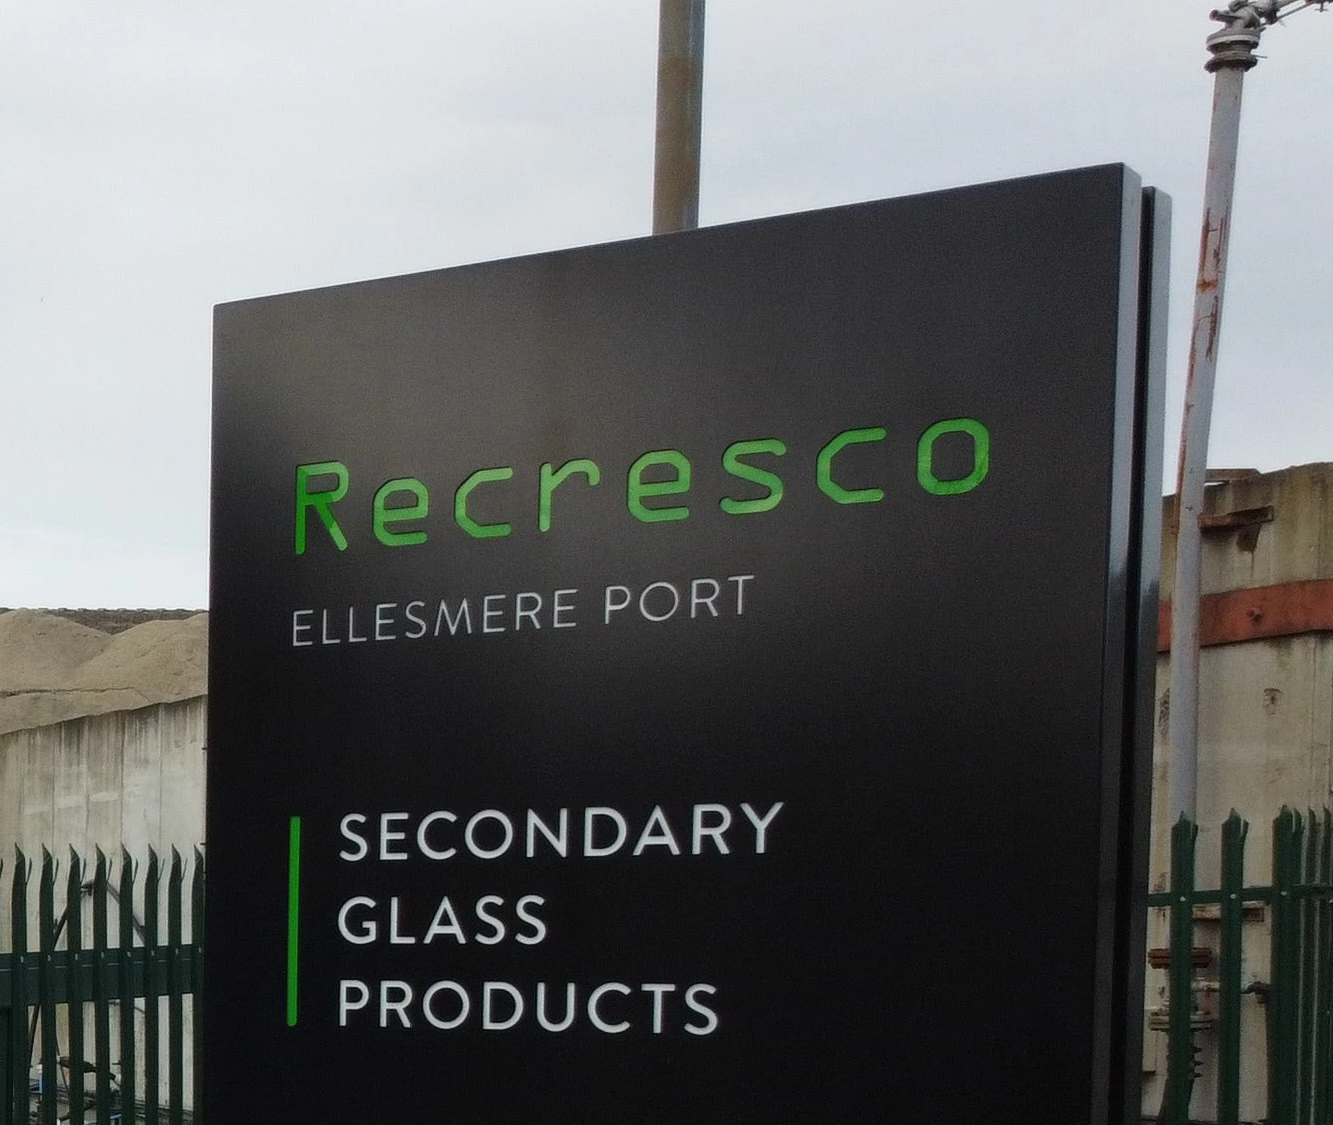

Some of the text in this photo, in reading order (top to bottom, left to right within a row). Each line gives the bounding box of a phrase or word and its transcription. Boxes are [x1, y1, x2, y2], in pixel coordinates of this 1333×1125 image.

[293, 416, 991, 555] Recresco
[291, 575, 756, 647] ELLESMERE PORT
[337, 801, 785, 863] SECONDARY
[337, 895, 548, 946] GLASS
[338, 979, 720, 1037] PRODUCTS
